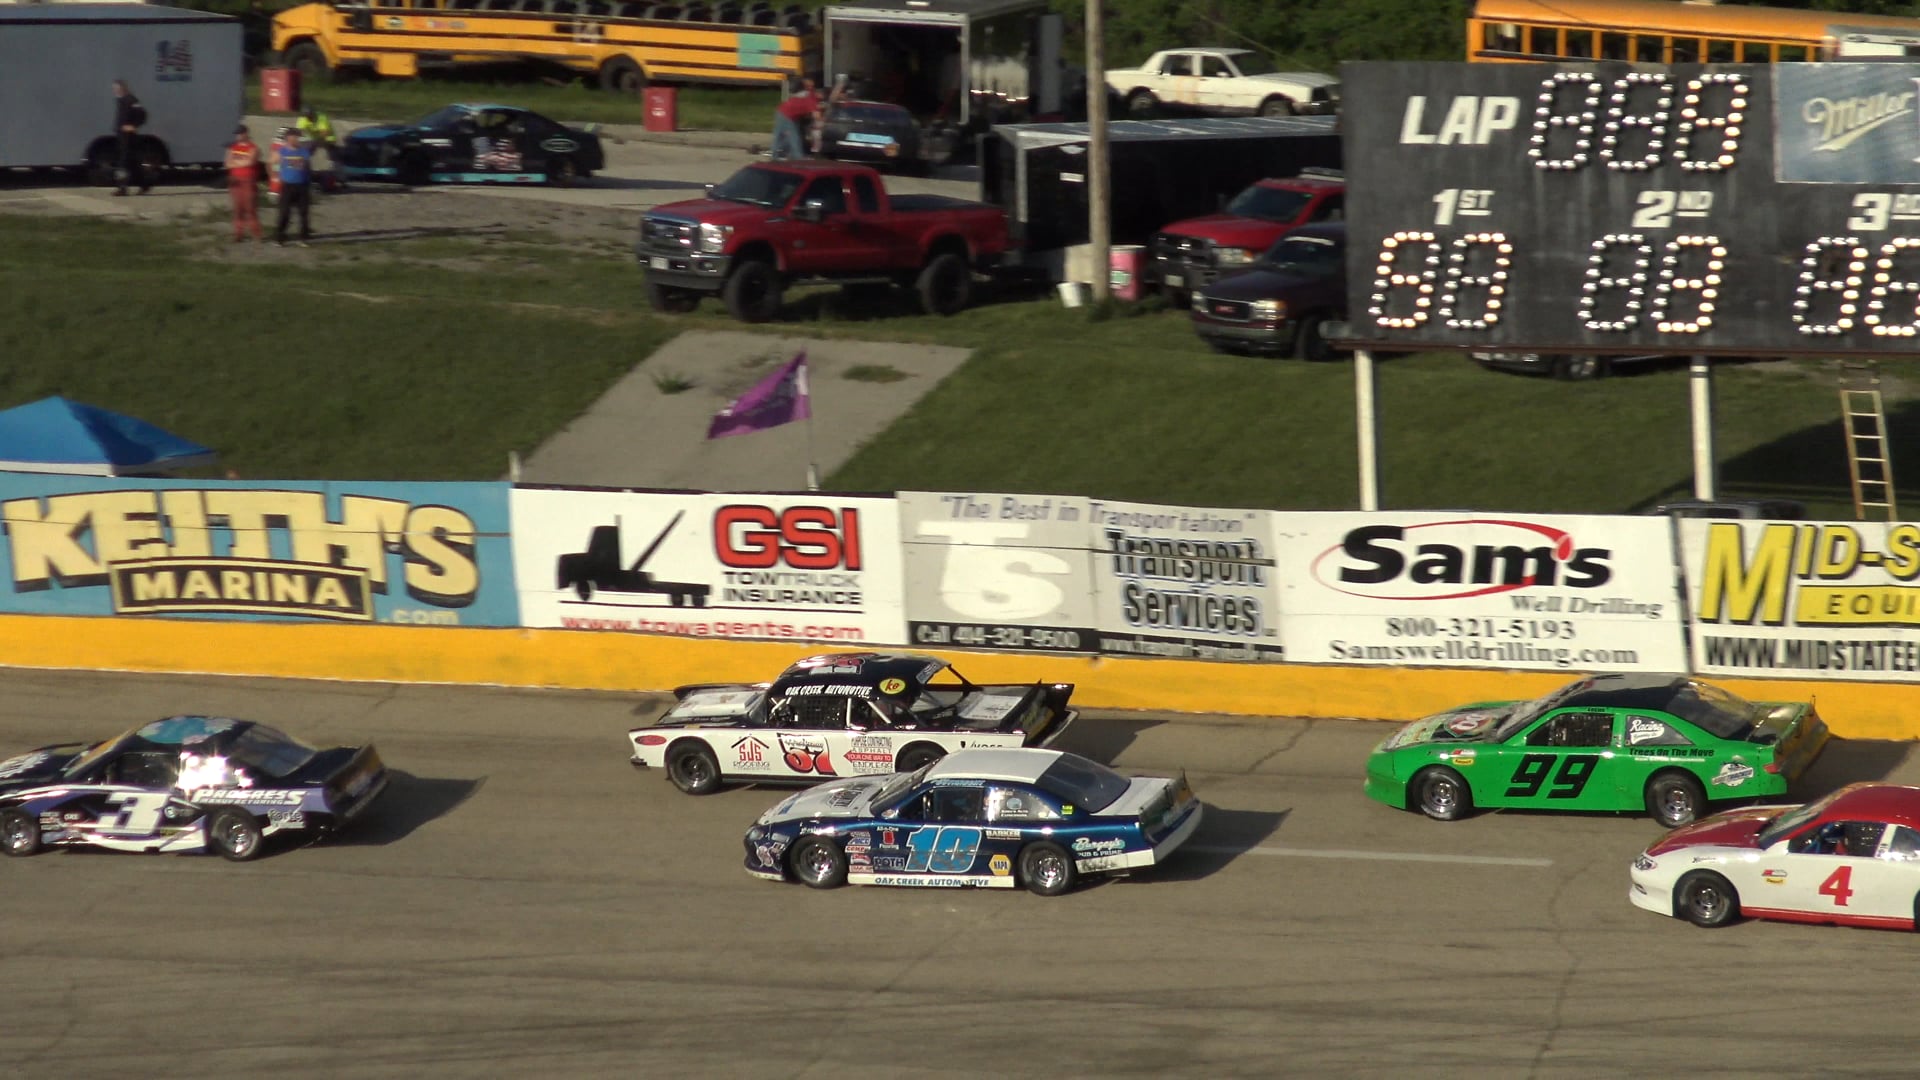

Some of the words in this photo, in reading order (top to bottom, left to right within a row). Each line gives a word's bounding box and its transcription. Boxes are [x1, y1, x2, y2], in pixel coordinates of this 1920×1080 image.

[1401, 96, 1520, 145] LAP
[1802, 91, 1915, 141] Miller
[1000, 497, 1051, 520] Best
[1056, 503, 1080, 522] in
[3, 489, 482, 608] KEITH'S
[713, 504, 863, 571] GSI
[1104, 529, 1266, 588] Transport
[1337, 525, 1613, 588] Sam's
[132, 570, 352, 608] MARINA
[722, 588, 864, 606] INSURANCE
[1122, 578, 1267, 637] Services
[1511, 594, 1563, 613] Well
[1568, 598, 1665, 620] Drilling
[560, 616, 865, 640] www.towagents.com
[917, 625, 950, 643] Call
[1386, 617, 1577, 640] 800-321-5193
[1329, 639, 1640, 668] Samswelldrilling.com
[800, 685, 826, 696] CREEK
[739, 742, 762, 761] SJS
[1630, 748, 1654, 756] Trees
[1689, 749, 1714, 757] Move
[1503, 753, 1600, 799] 99
[191, 788, 306, 806] PROGRESS
[95, 791, 169, 837] 3
[904, 824, 982, 874] 10
[896, 877, 924, 886] CREEK
[1818, 865, 1854, 907] 4
